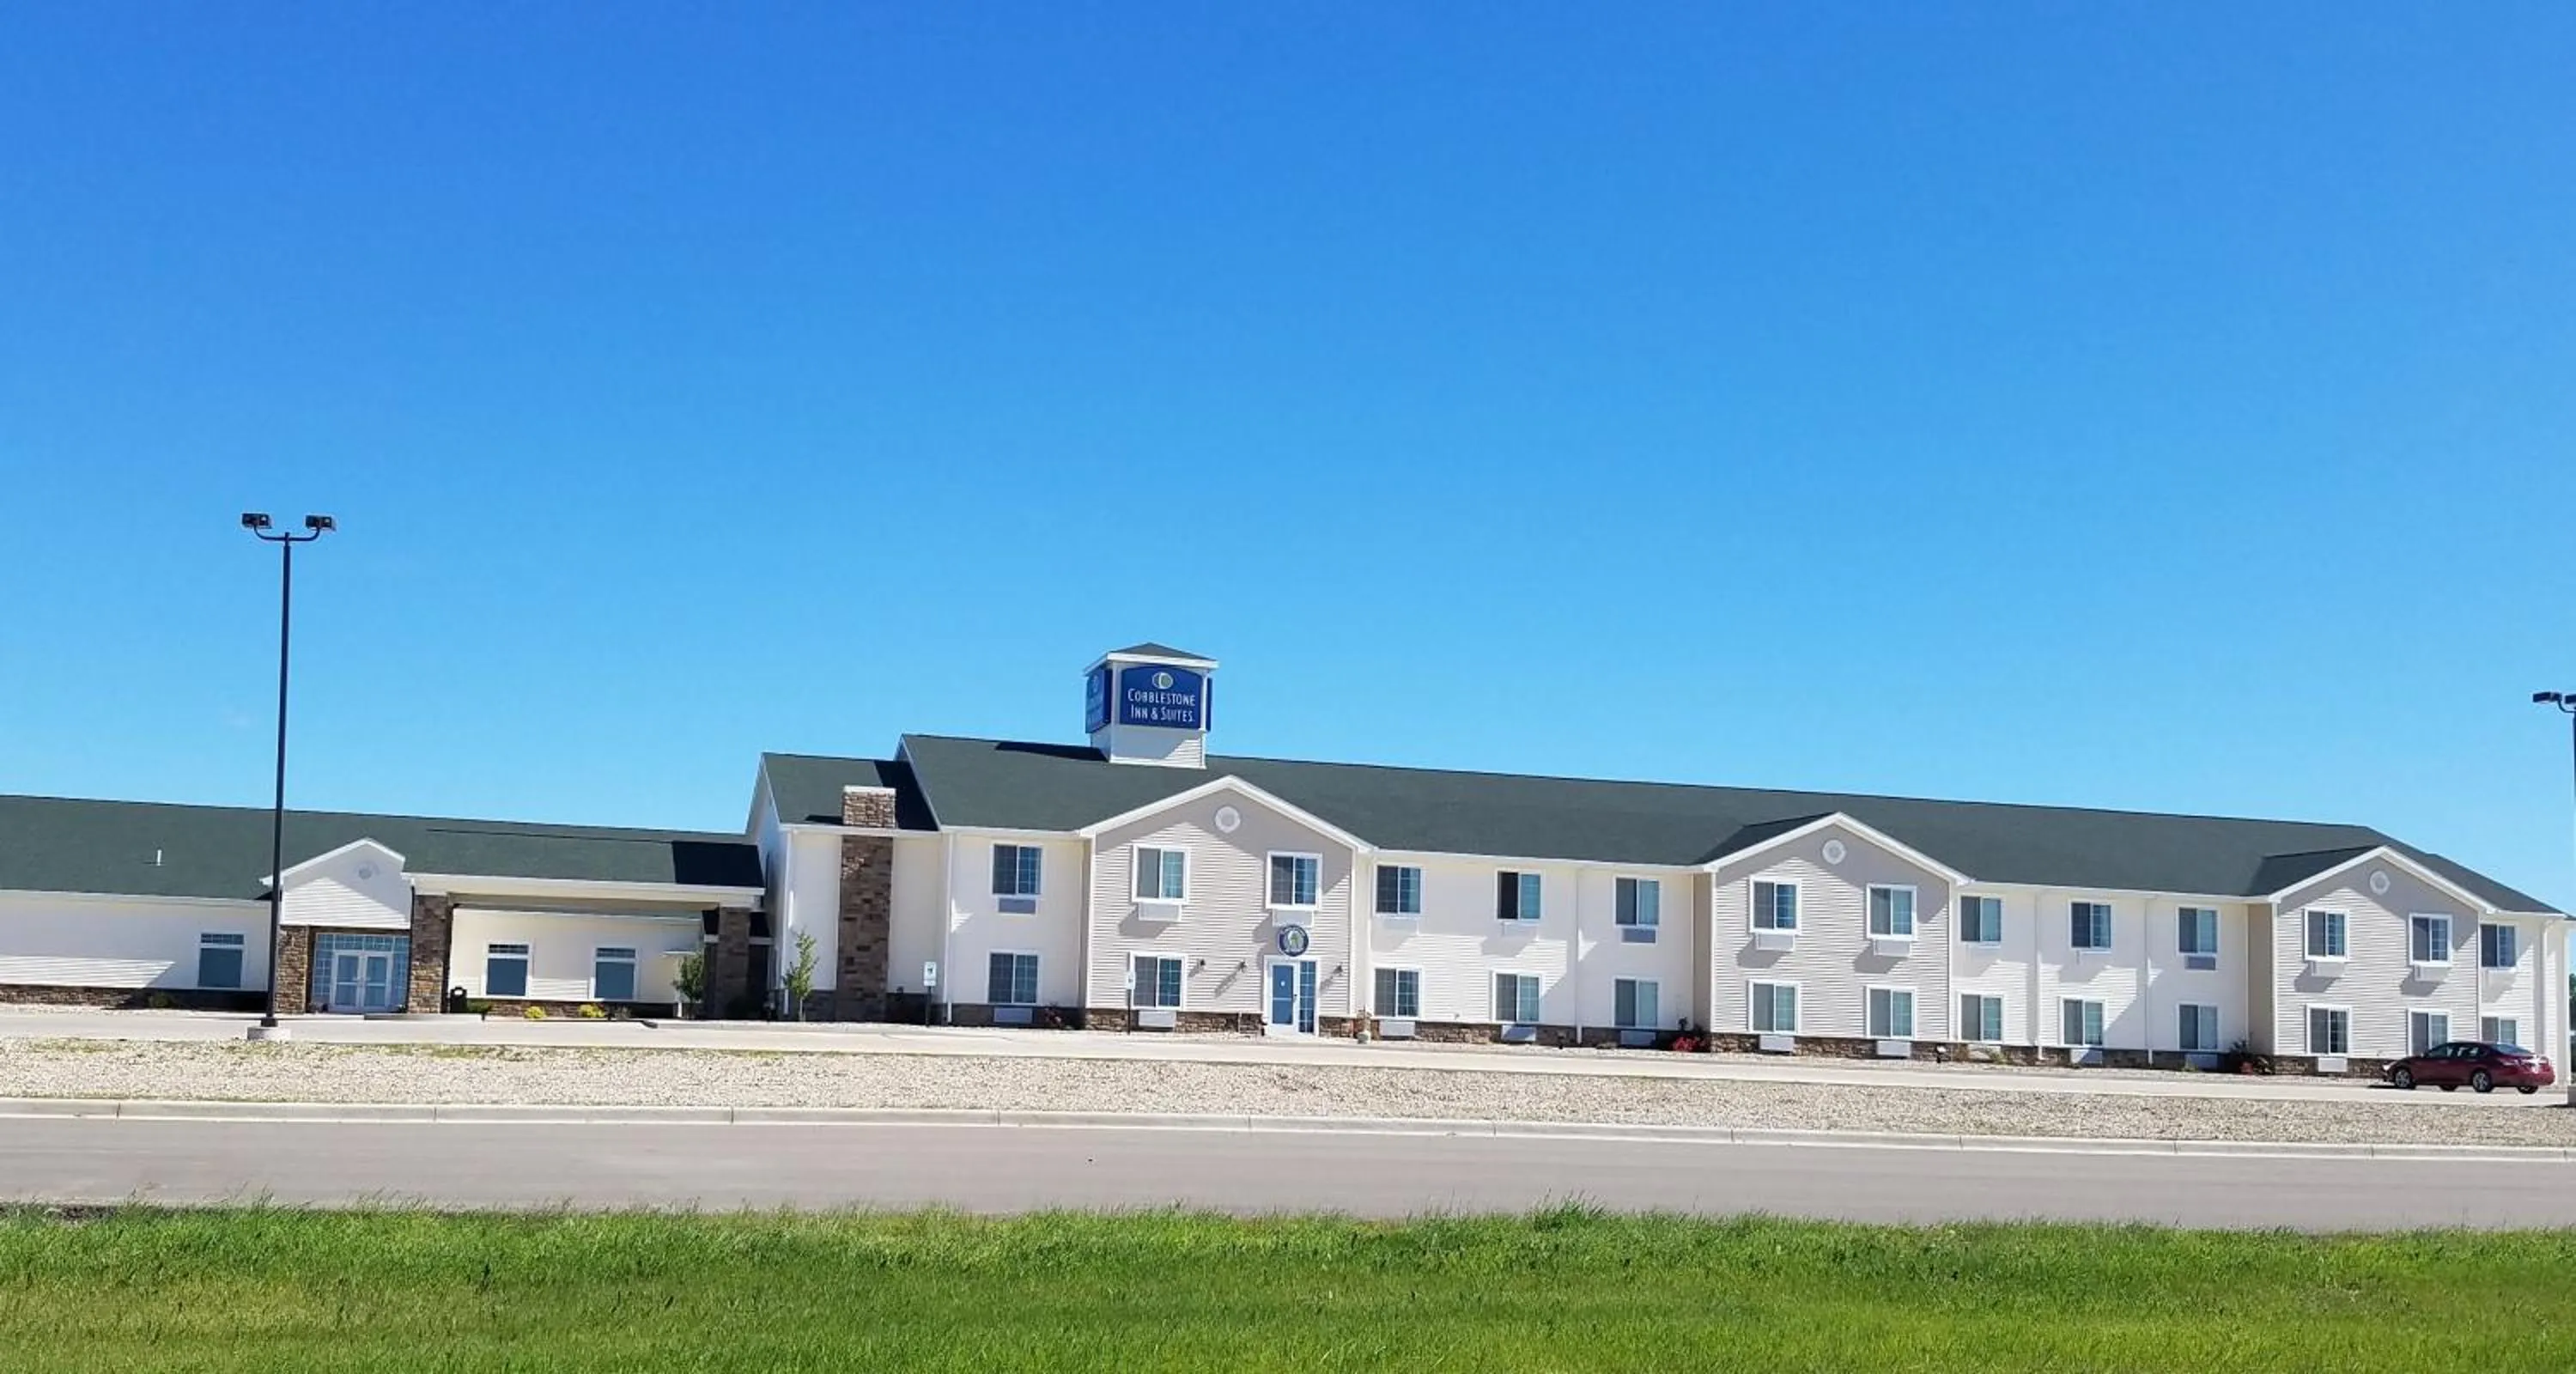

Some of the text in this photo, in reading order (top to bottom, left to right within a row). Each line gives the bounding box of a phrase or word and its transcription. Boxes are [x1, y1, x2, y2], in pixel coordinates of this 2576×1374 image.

[1127, 688, 1196, 706] COBBLESTONE
[1131, 705, 1194, 722] INN & SUITES
